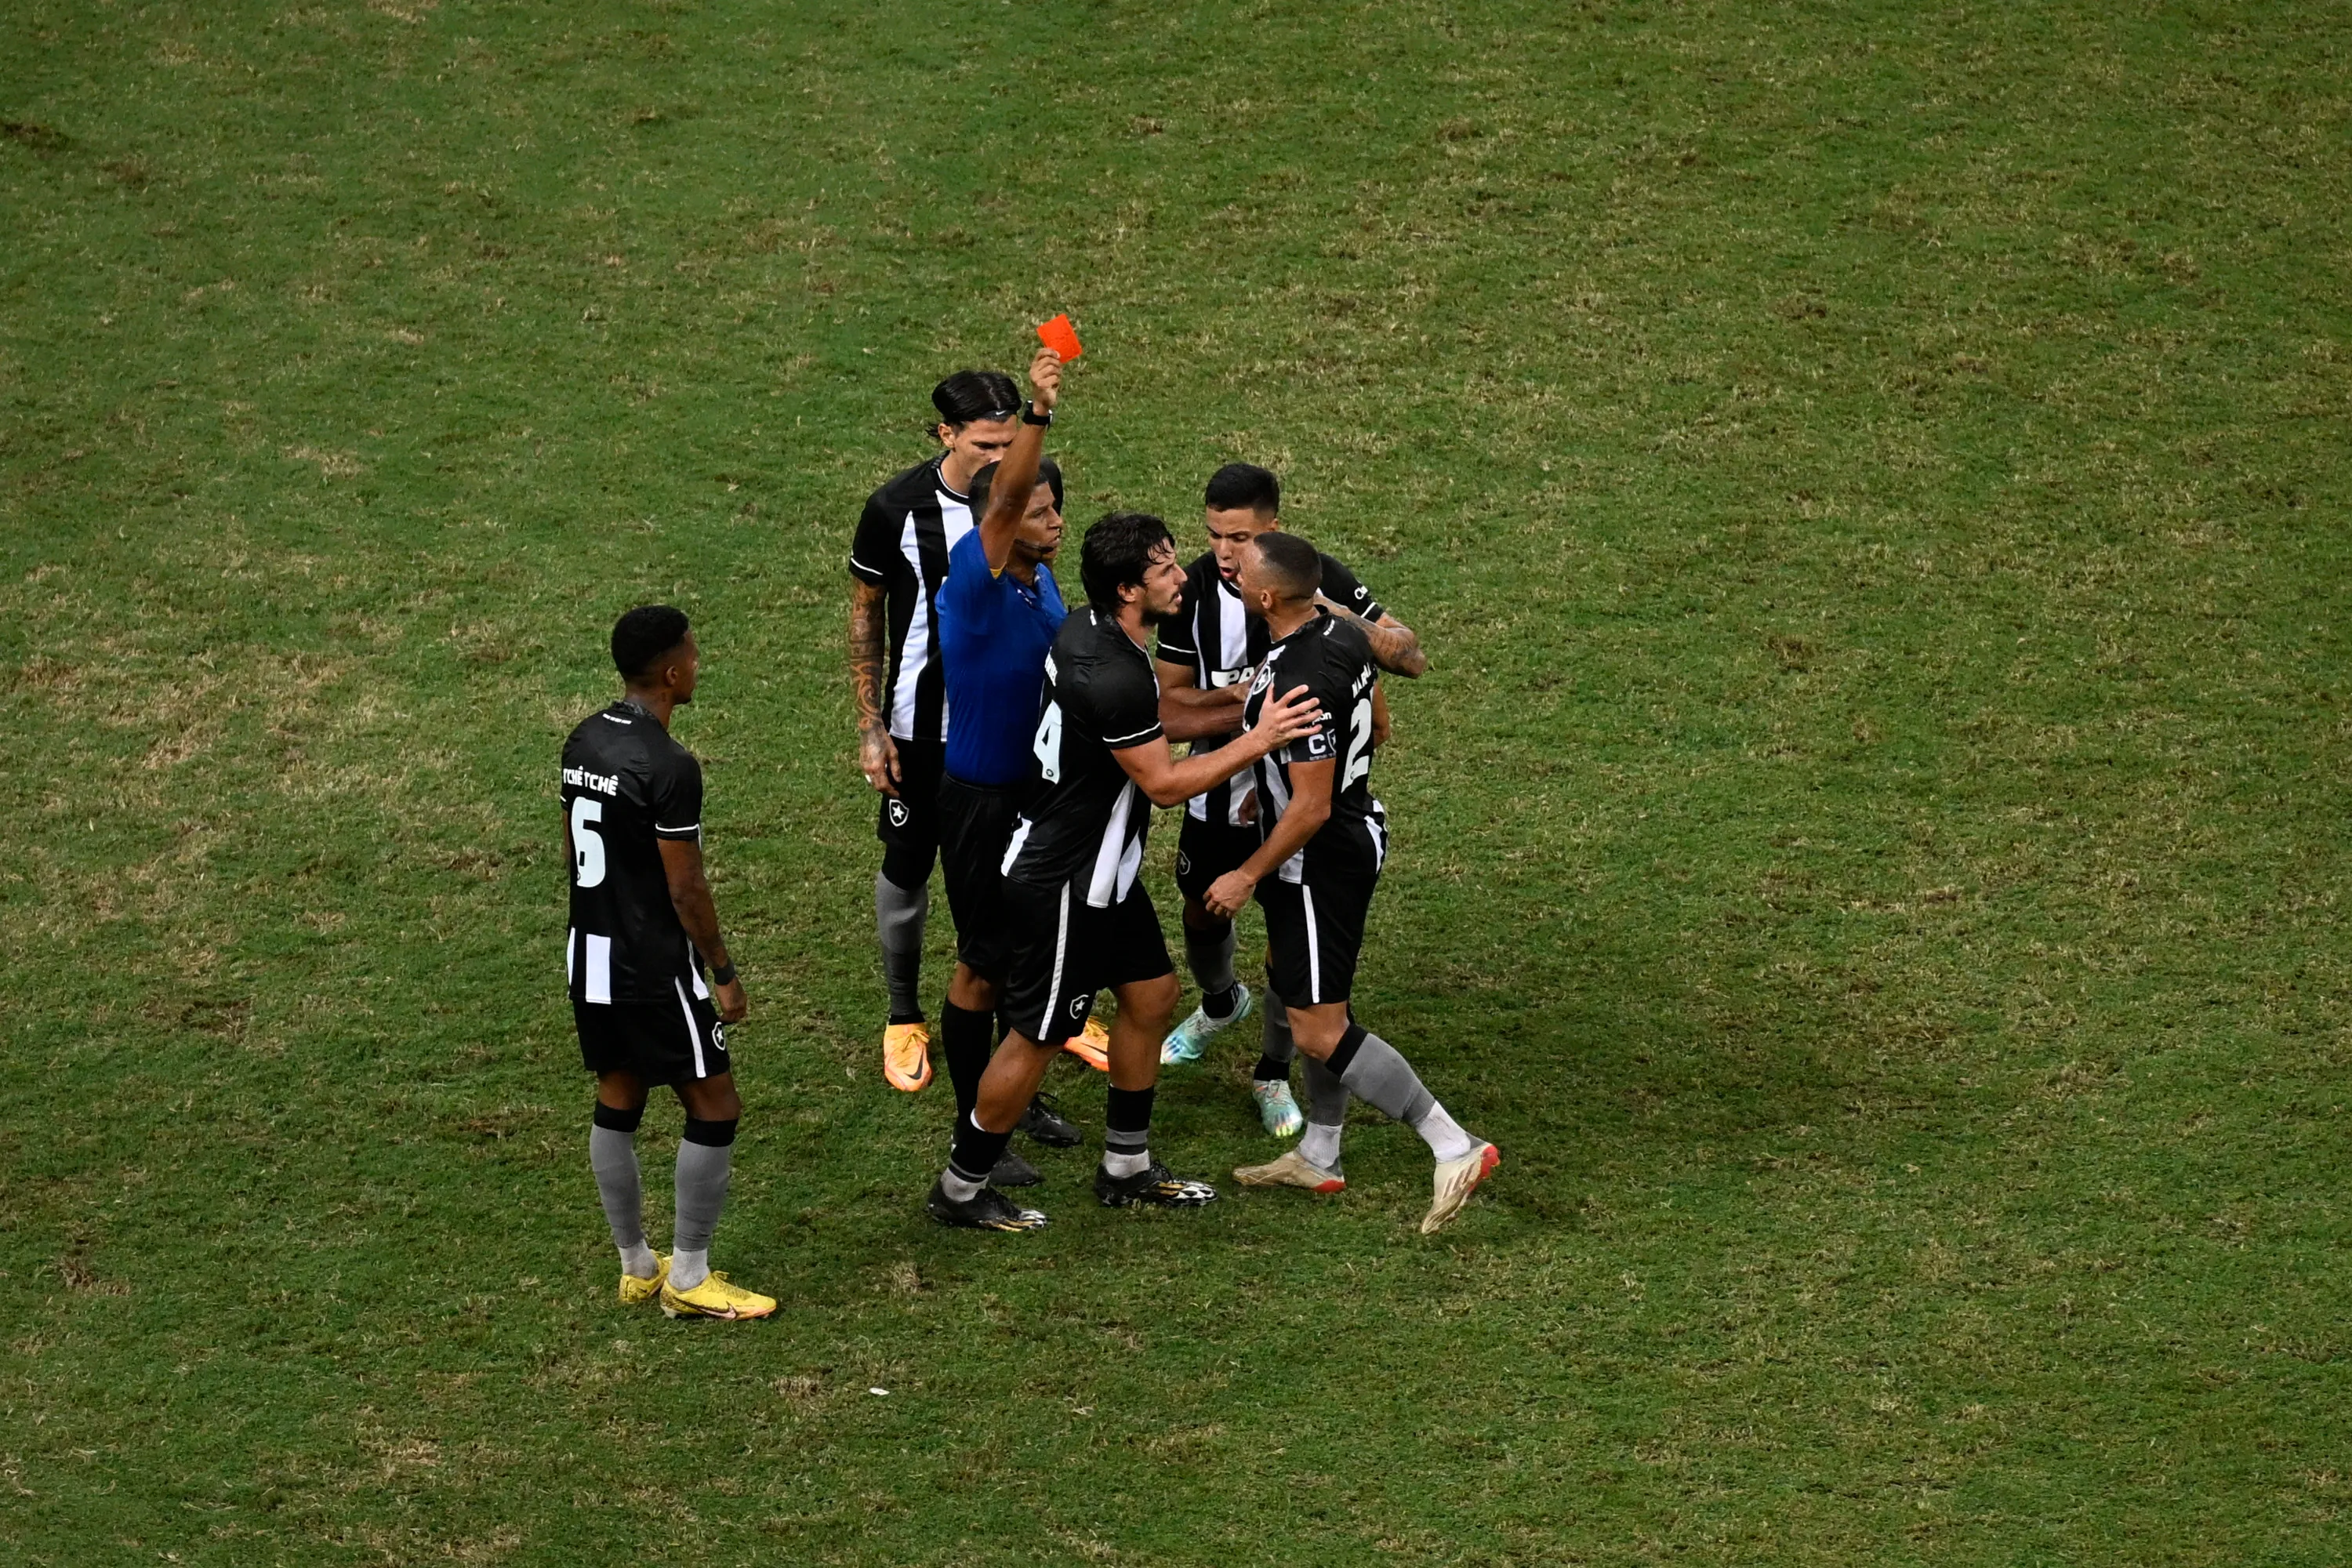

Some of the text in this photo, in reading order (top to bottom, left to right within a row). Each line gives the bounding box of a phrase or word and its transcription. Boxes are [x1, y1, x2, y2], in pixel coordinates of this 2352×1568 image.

[583, 771, 619, 797] TCHÊ
[1033, 699, 1062, 786] 4
[1308, 733, 1327, 755] C
[1340, 690, 1374, 794] 2
[571, 796, 606, 888] 6
